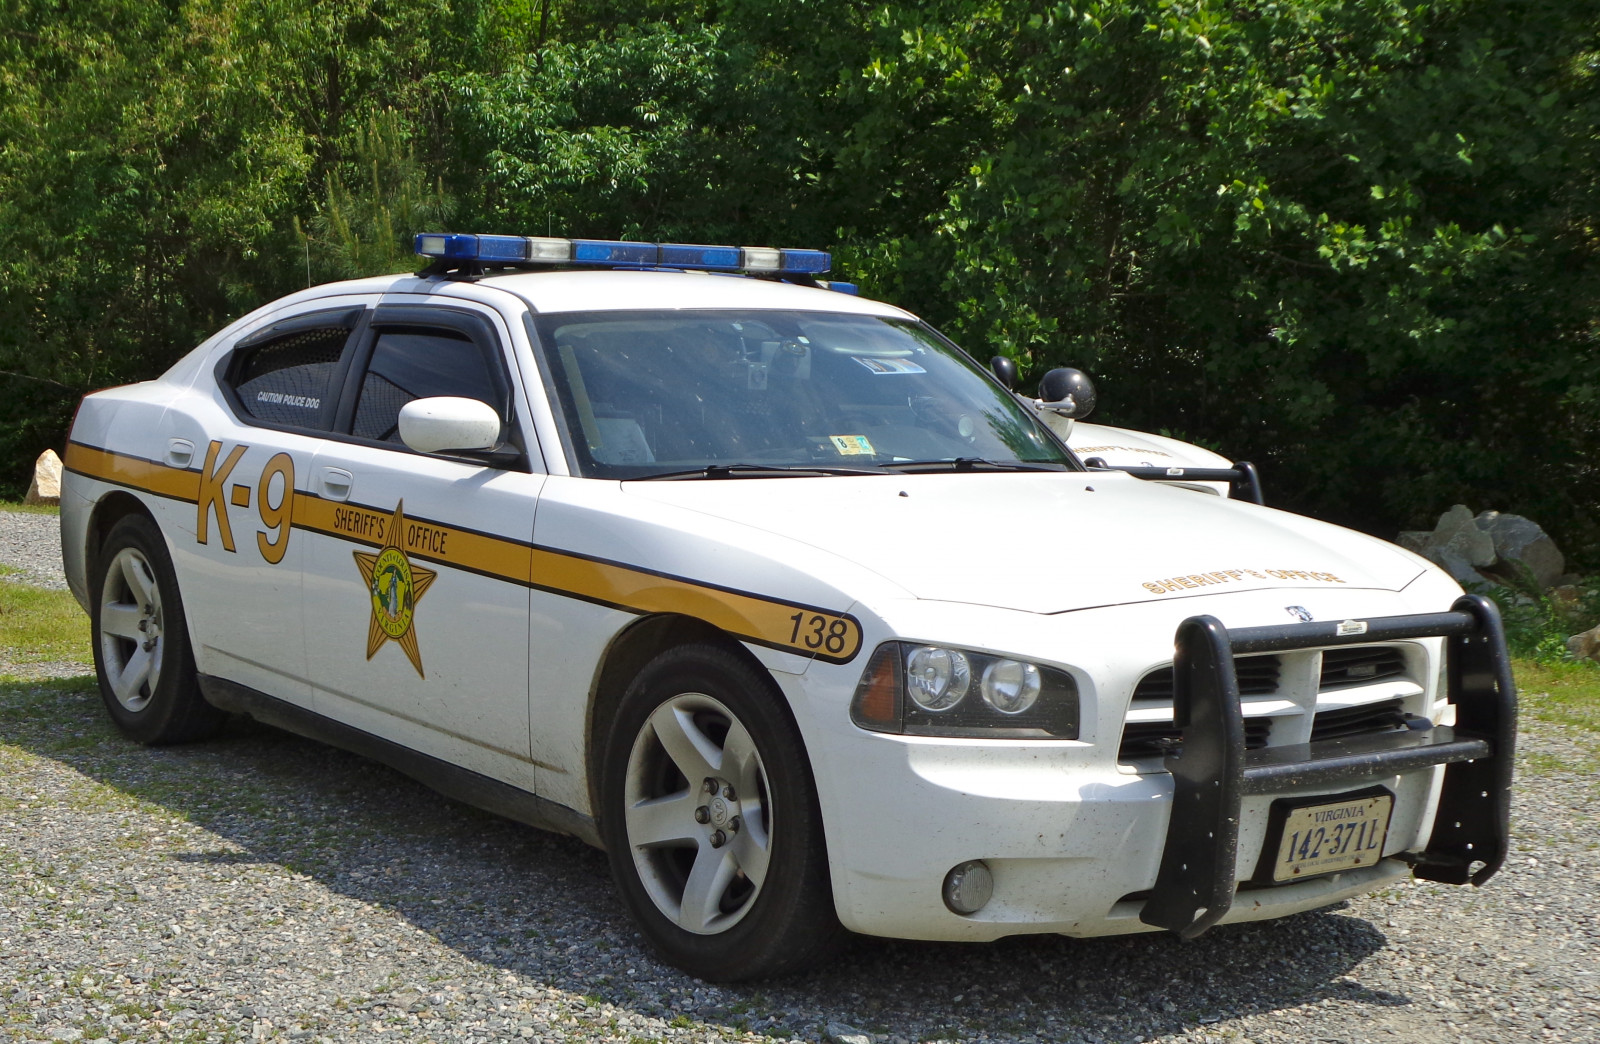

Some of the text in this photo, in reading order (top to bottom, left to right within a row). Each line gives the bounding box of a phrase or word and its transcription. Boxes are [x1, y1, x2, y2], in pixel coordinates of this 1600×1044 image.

[257, 391, 320, 409] CAUTION POLICE DOG
[197, 440, 295, 565] K-9
[333, 507, 448, 555] SHERIFF'S OFFICE
[1142, 568, 1347, 594] SHERIFF'S OFFICE
[789, 611, 848, 654] 138
[1315, 805, 1365, 823] VIRGINIA
[1286, 818, 1379, 863] 142-371L
